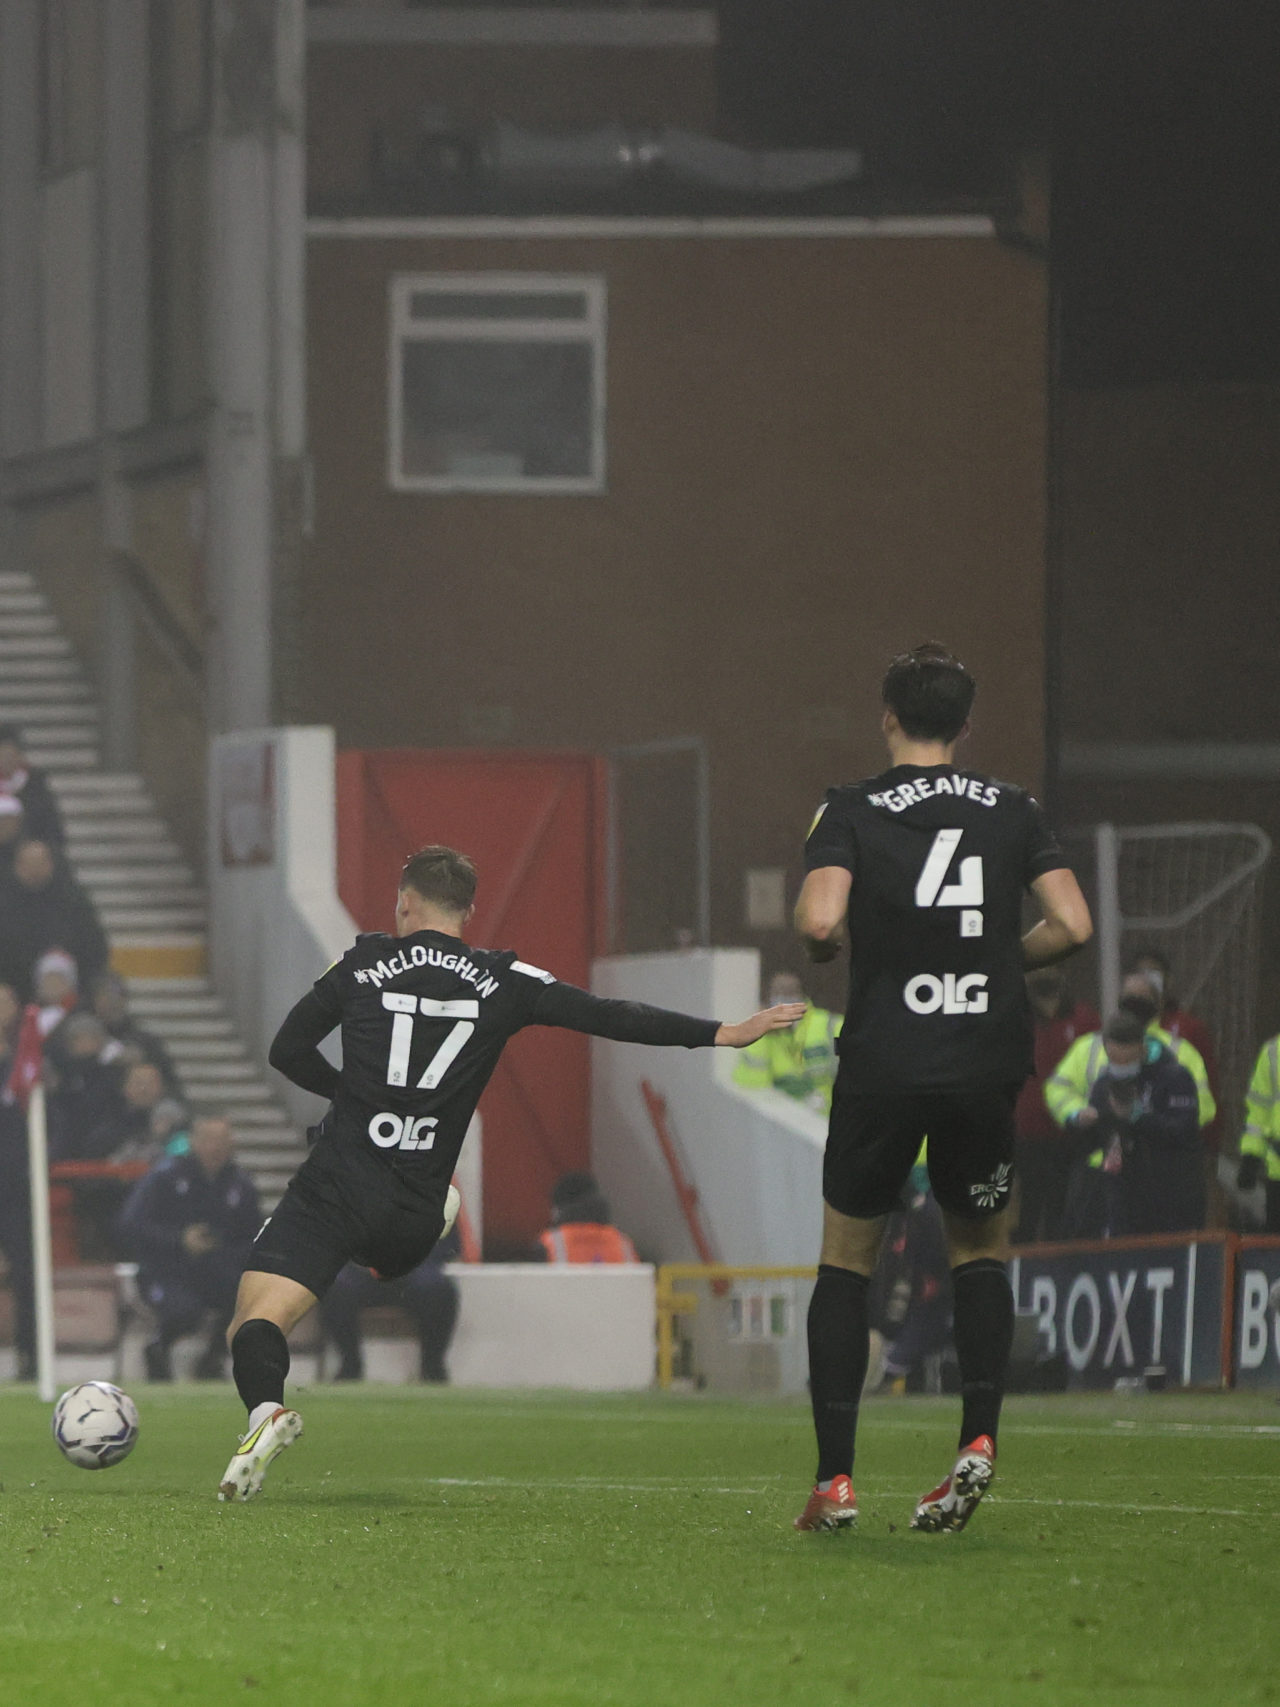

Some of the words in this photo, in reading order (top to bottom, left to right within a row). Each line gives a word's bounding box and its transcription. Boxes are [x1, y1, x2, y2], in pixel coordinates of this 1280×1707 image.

[883, 773, 1001, 813] GREAVES
[914, 828, 984, 937] 4
[903, 973, 989, 1015] OLG
[381, 991, 479, 1090] 17
[368, 1112, 439, 1151] OLG
